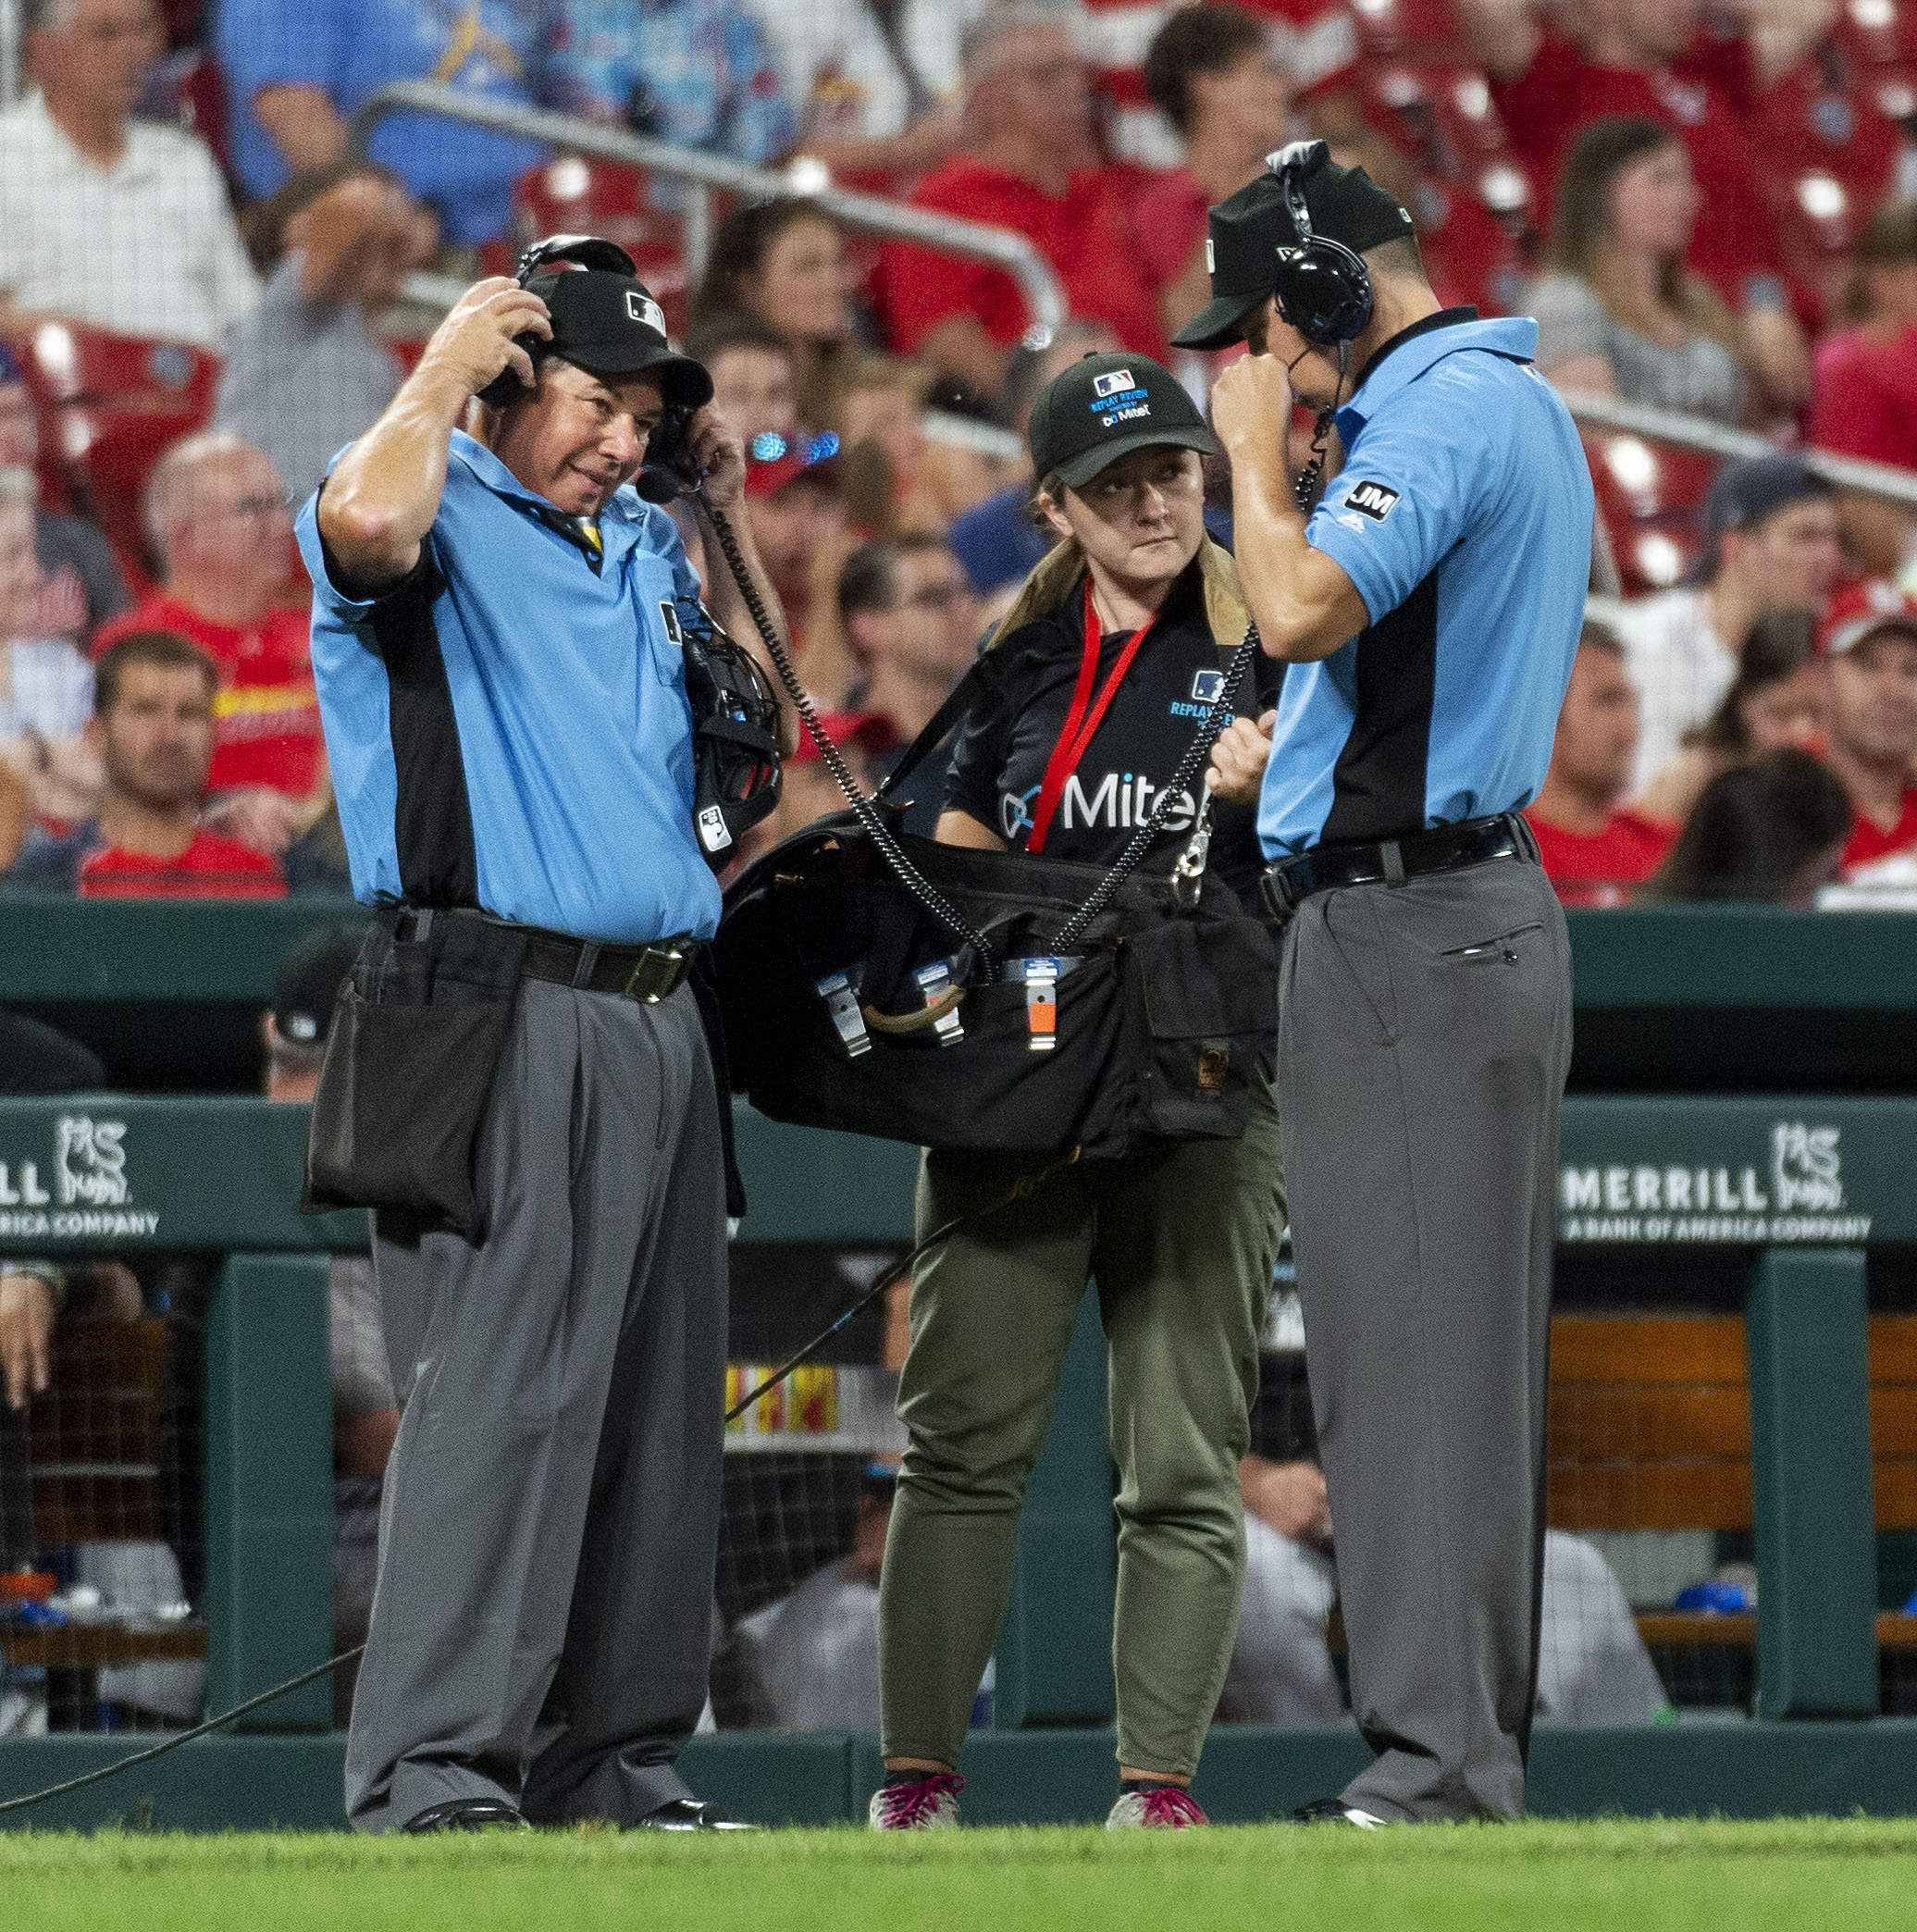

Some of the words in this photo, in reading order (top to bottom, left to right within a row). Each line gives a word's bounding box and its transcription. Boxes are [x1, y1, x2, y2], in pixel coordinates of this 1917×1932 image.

[1118, 404, 1151, 421] Mitel
[1350, 487, 1396, 514] JM
[1562, 1167, 1769, 1211] MERRILL
[52, 1212, 160, 1236] COMPANY
[1566, 1217, 1581, 1241] A
[1771, 1217, 1873, 1241] COMPANY
